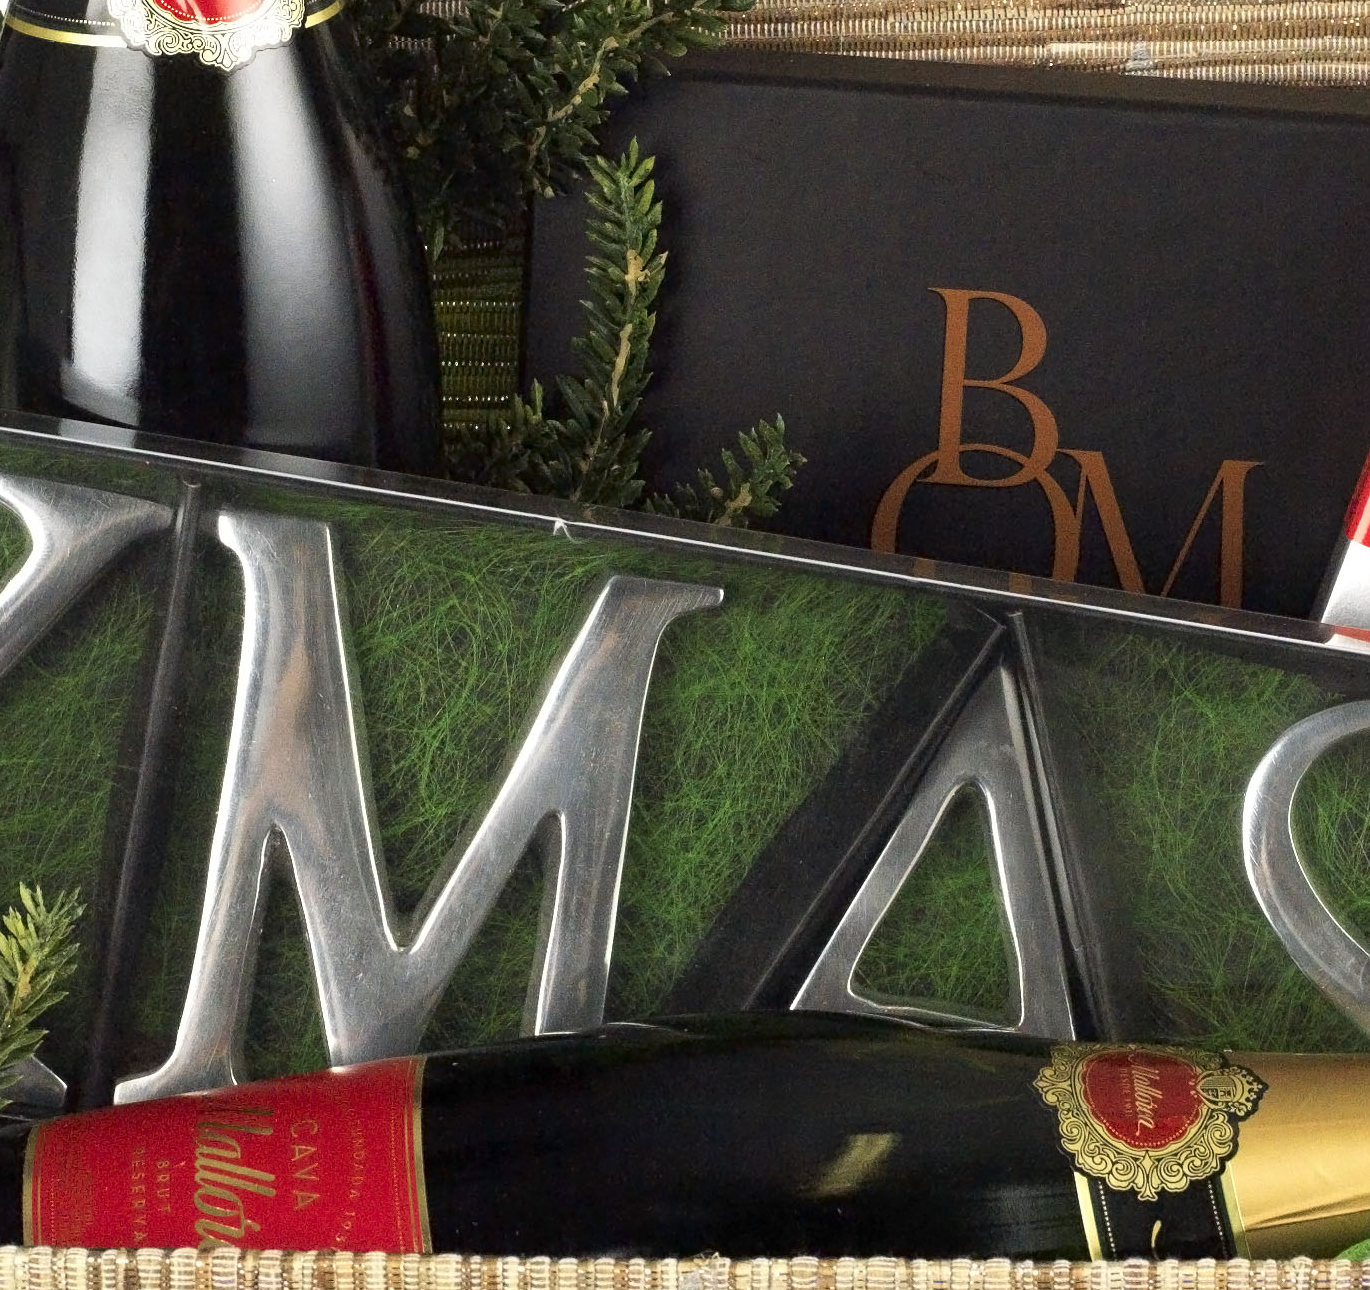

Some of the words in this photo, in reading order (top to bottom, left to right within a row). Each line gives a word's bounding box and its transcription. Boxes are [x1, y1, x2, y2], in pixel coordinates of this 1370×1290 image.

[1128, 1053, 1163, 1136] Mallorca
[156, 1160, 171, 1212] BRUT
[193, 1106, 277, 1248] Mallor
[290, 1119, 321, 1210] CAVA
